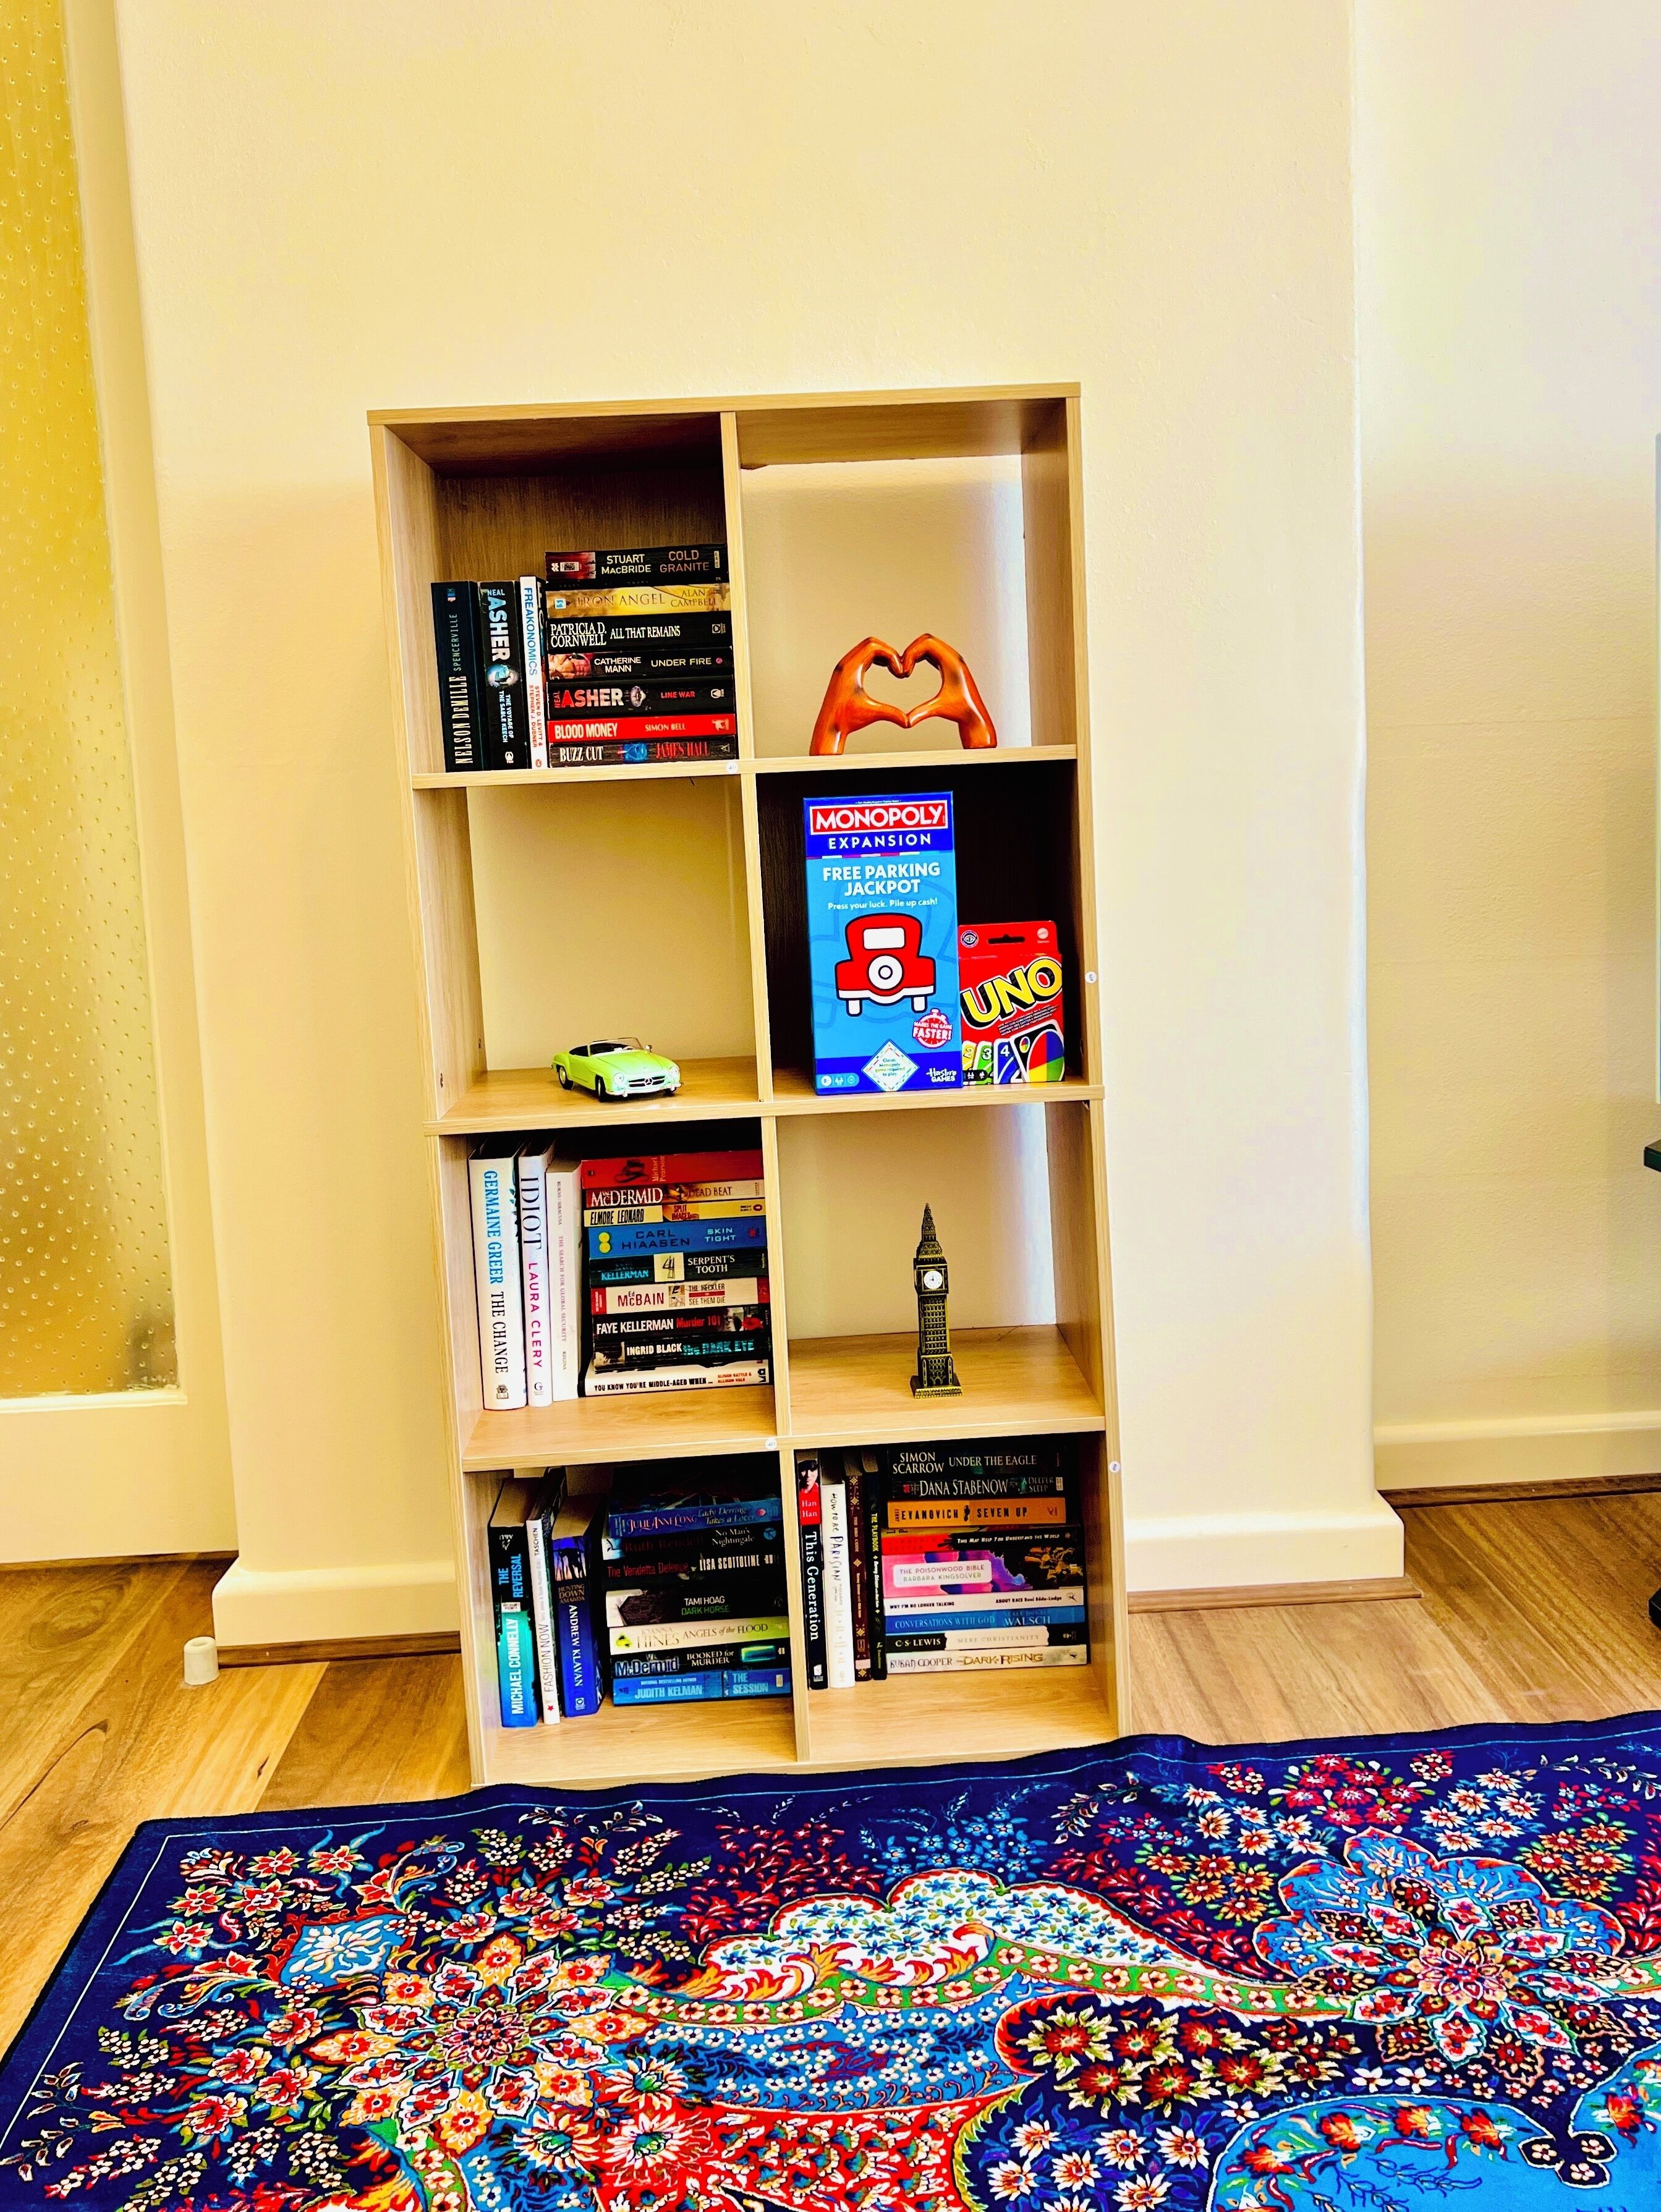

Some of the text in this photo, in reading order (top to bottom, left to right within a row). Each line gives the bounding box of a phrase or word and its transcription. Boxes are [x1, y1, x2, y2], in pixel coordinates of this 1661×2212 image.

[606, 554, 645, 564] STUART
[668, 549, 699, 561] COLD
[660, 562, 710, 573] GRANITE
[487, 588, 506, 596] NEAL
[681, 588, 706, 598] ALAN
[619, 593, 666, 606] ANGEL
[671, 598, 717, 608] CAMPBELL
[488, 596, 511, 662] ASHER
[524, 588, 537, 676] FREAKONOMICS
[550, 622, 596, 636] PATRICIA
[610, 625, 681, 640] ALL THAT REMAINS
[449, 614, 462, 671] SPENCERVILLE
[551, 634, 607, 648] CORNWELL
[594, 657, 642, 666] CATHERINE
[651, 658, 712, 667] UNDER FIRE
[605, 664, 632, 673] MANN
[561, 688, 624, 708] ASHER
[554, 723, 618, 739] BLOOD MONEY
[645, 723, 686, 732] SIMON BELL
[509, 731, 514, 739] OF
[452, 723, 474, 765] NELSON
[559, 745, 604, 762] BUZZ CUT
[815, 805, 943, 830] MONOPOLY
[828, 833, 932, 850] EXPANSION
[823, 862, 940, 881] FREE PARKING
[844, 879, 921, 897] JACKPOT
[850, 902, 867, 910] your
[906, 900, 917, 908] up
[918, 898, 938, 906] cash!
[962, 958, 1063, 1024] UNO
[912, 1027, 952, 1040] FASTER!
[1000, 1045, 1010, 1057] 4
[591, 1187, 663, 1207] McDERMID
[713, 1186, 733, 1196] BEAT
[520, 1177, 542, 1250] IDIOT
[590, 1208, 644, 1225] ELMORE LEONARD
[484, 1170, 504, 1284] GERMAINE GREER
[635, 1231, 676, 1239] CARL
[622, 1238, 690, 1250] HIAASEN
[687, 1255, 735, 1266] SERPENT'S
[601, 1269, 649, 1280] KELLERMAN
[696, 1265, 728, 1274] TOOTH
[618, 1292, 664, 1307] McBAIN
[529, 1263, 543, 1368] LAURA CLERY
[491, 1291, 509, 1373] THE CHANGE
[597, 1318, 674, 1335] FAYE KELLERMAN
[626, 1342, 682, 1355] INGRID BLACK
[648, 1378, 687, 1388] MIDDLE-AGED
[899, 1452, 935, 1463] SIMON
[949, 1455, 1037, 1467] UNDER THE EAGLE
[893, 1462, 945, 1474] SCARROW
[919, 1478, 1008, 1497] DANA STABENOW
[901, 1509, 959, 1520] EVANOVICH
[977, 1507, 1027, 1519] SEVEN UP
[699, 1558, 716, 1571] LISA
[915, 1566, 963, 1574] POISONWOOD
[498, 1567, 509, 1586] THE
[511, 1553, 524, 1598] REVERSAL
[938, 1572, 982, 1580] KINGSOLVER
[805, 1531, 821, 1641] This Generation
[684, 1596, 725, 1606] TAMI HOAG
[681, 1605, 730, 1616] DARK HORSE
[894, 1614, 995, 1629] CONVERSATIONS WITH GOD
[1004, 1616, 1051, 1626] WALSCH
[538, 1624, 550, 1648] NOW
[683, 1629, 717, 1638] ANGELS
[737, 1624, 768, 1635] FLOOD
[506, 1617, 521, 1668] CONNELLY
[913, 1638, 941, 1646] LEWIS
[980, 1634, 1040, 1643] CHRISTIANITY
[569, 1604, 583, 1687] ANDREW KLAVAN
[687, 1651, 723, 1661] BOOKED
[691, 1656, 730, 1667] MURDER
[917, 1657, 953, 1667] COOPER
[540, 1648, 554, 1692] FASHION
[733, 1672, 748, 1683] THE
[509, 1669, 524, 1714] MICHAEL
[634, 1685, 702, 1699] JUDITH KELMAN
[733, 1682, 769, 1694] SESSION
